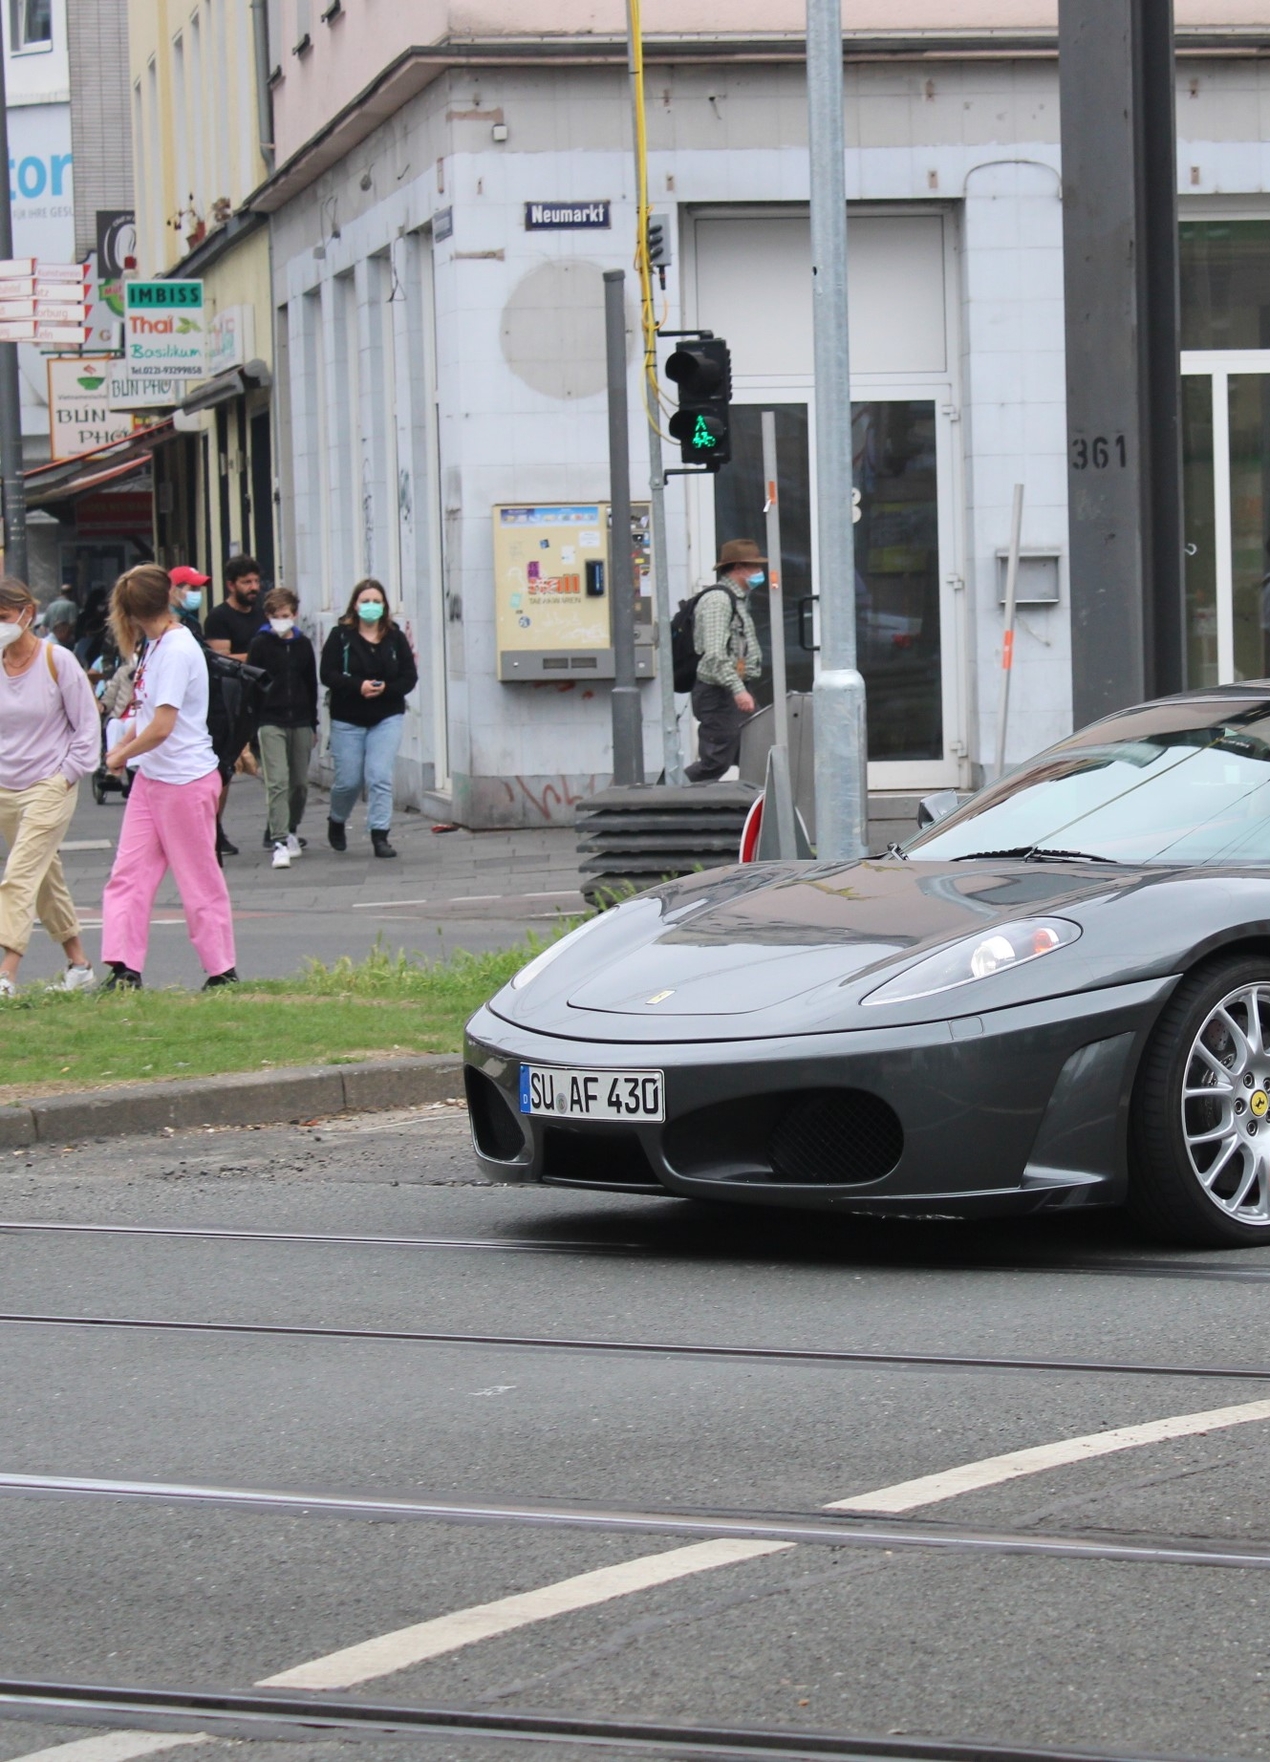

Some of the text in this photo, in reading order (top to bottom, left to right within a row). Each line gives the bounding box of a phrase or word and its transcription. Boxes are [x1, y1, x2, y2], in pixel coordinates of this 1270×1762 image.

[531, 204, 604, 223] Neumarkt
[130, 287, 200, 304] IMBISS
[129, 315, 174, 334] Thai
[130, 343, 202, 359] Basilikum
[1072, 434, 1127, 470] 361
[531, 1072, 659, 1114] SU AF 430
